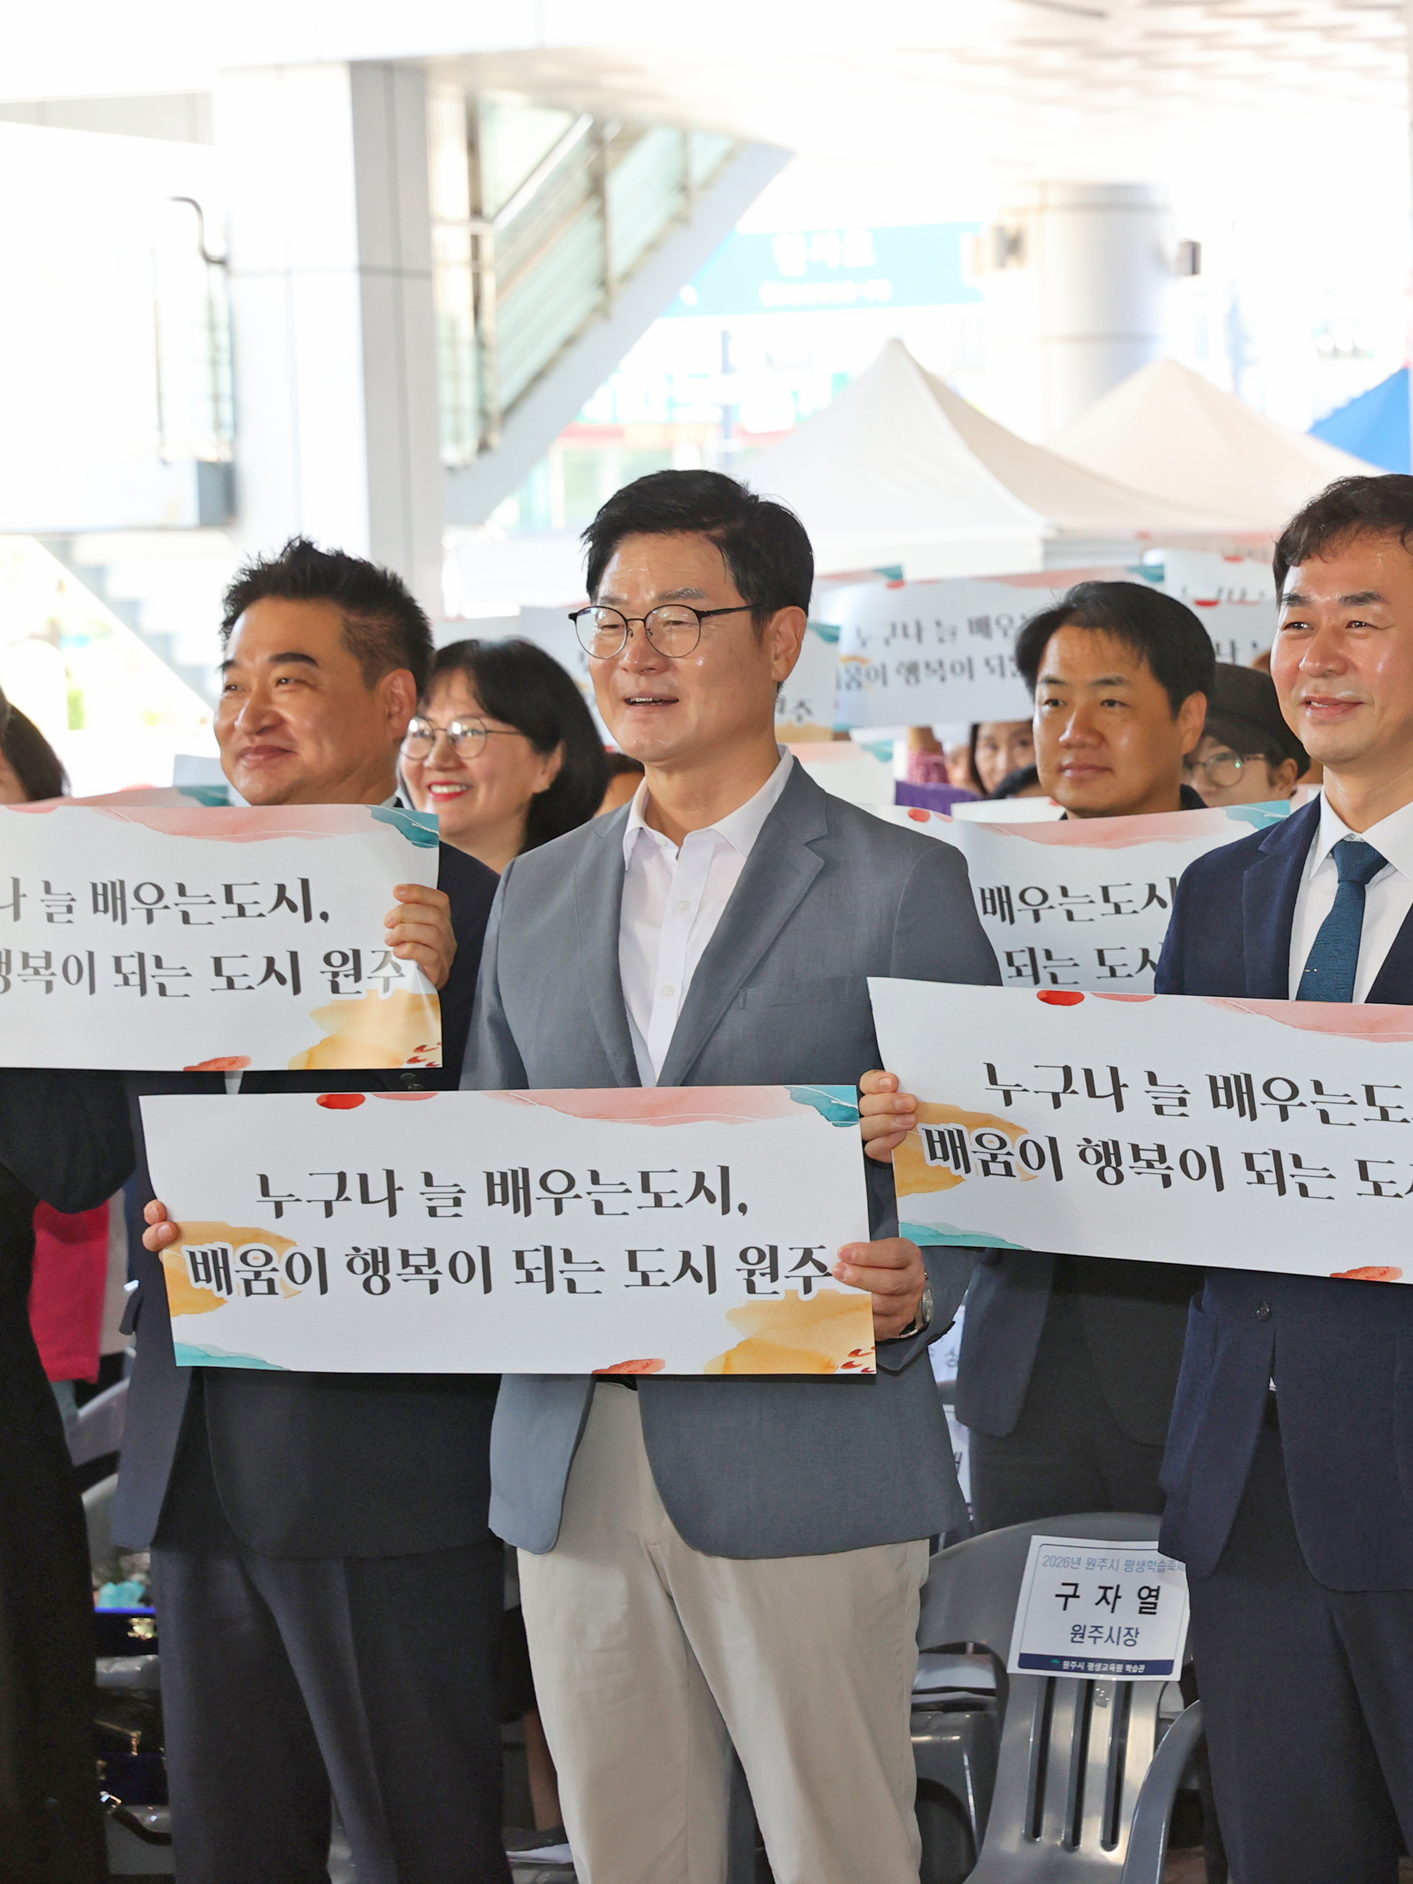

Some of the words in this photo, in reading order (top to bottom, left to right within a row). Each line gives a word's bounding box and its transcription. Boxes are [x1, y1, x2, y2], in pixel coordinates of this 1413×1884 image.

[41, 881, 76, 923] 늘
[90, 878, 329, 925] 배우는도시,
[113, 952, 192, 997] 되는
[211, 950, 301, 996] 도시
[320, 948, 406, 994] 원주
[1004, 947, 1080, 986] 되는
[983, 1063, 1129, 1116] 누구나
[1144, 1071, 1191, 1117] 늘
[921, 1126, 1063, 1183] 배움이
[1076, 1138, 1224, 1192] 행복이
[1241, 1149, 1336, 1200] 되는
[257, 1169, 404, 1219] 누구나
[420, 1172, 466, 1217] 늘
[483, 1165, 747, 1217] 배우는도시,
[186, 1242, 328, 1302] 배움이
[345, 1245, 492, 1295] 행복이
[512, 1245, 605, 1294] 되는
[624, 1245, 717, 1295] 도시
[736, 1244, 835, 1295] 원주
[1042, 1554, 1082, 1570] 2026년
[1085, 1557, 1120, 1572] 원주시
[1070, 1624, 1140, 1647] 원주시장
